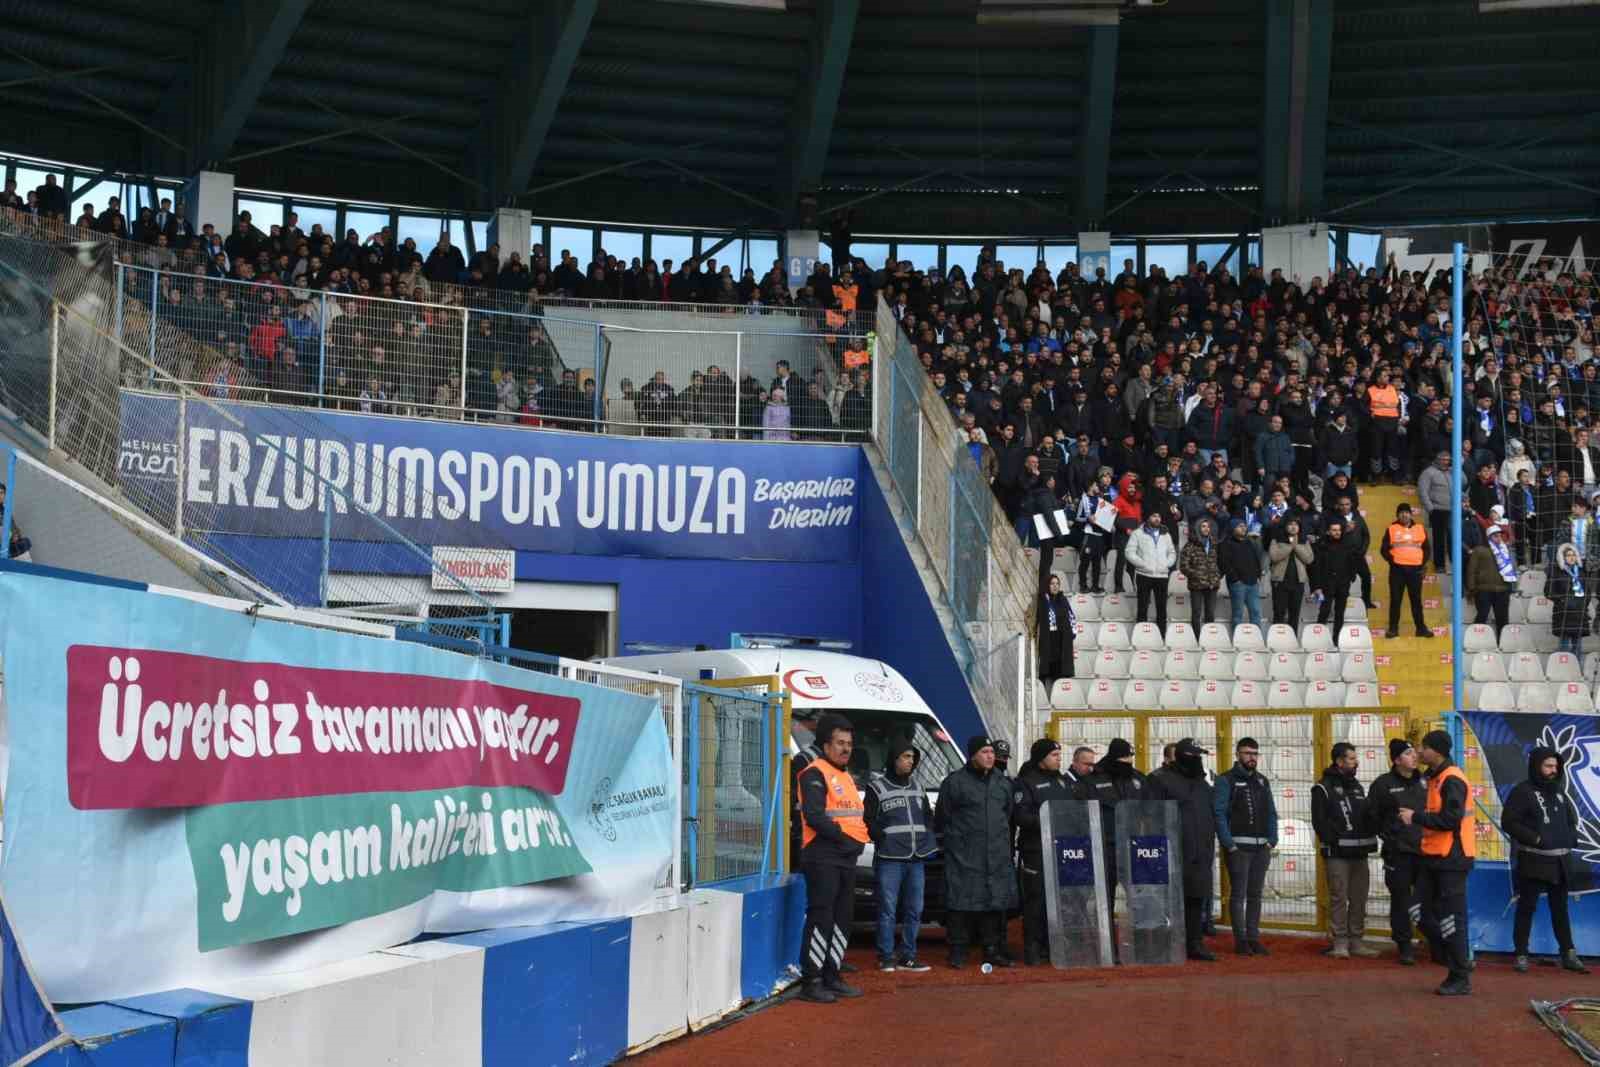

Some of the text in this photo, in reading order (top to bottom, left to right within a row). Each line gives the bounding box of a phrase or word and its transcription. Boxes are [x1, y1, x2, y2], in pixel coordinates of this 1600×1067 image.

[98, 656, 303, 763] Ücretsiz
[306, 691, 477, 755] taramanı
[220, 831, 384, 923] yaşam
